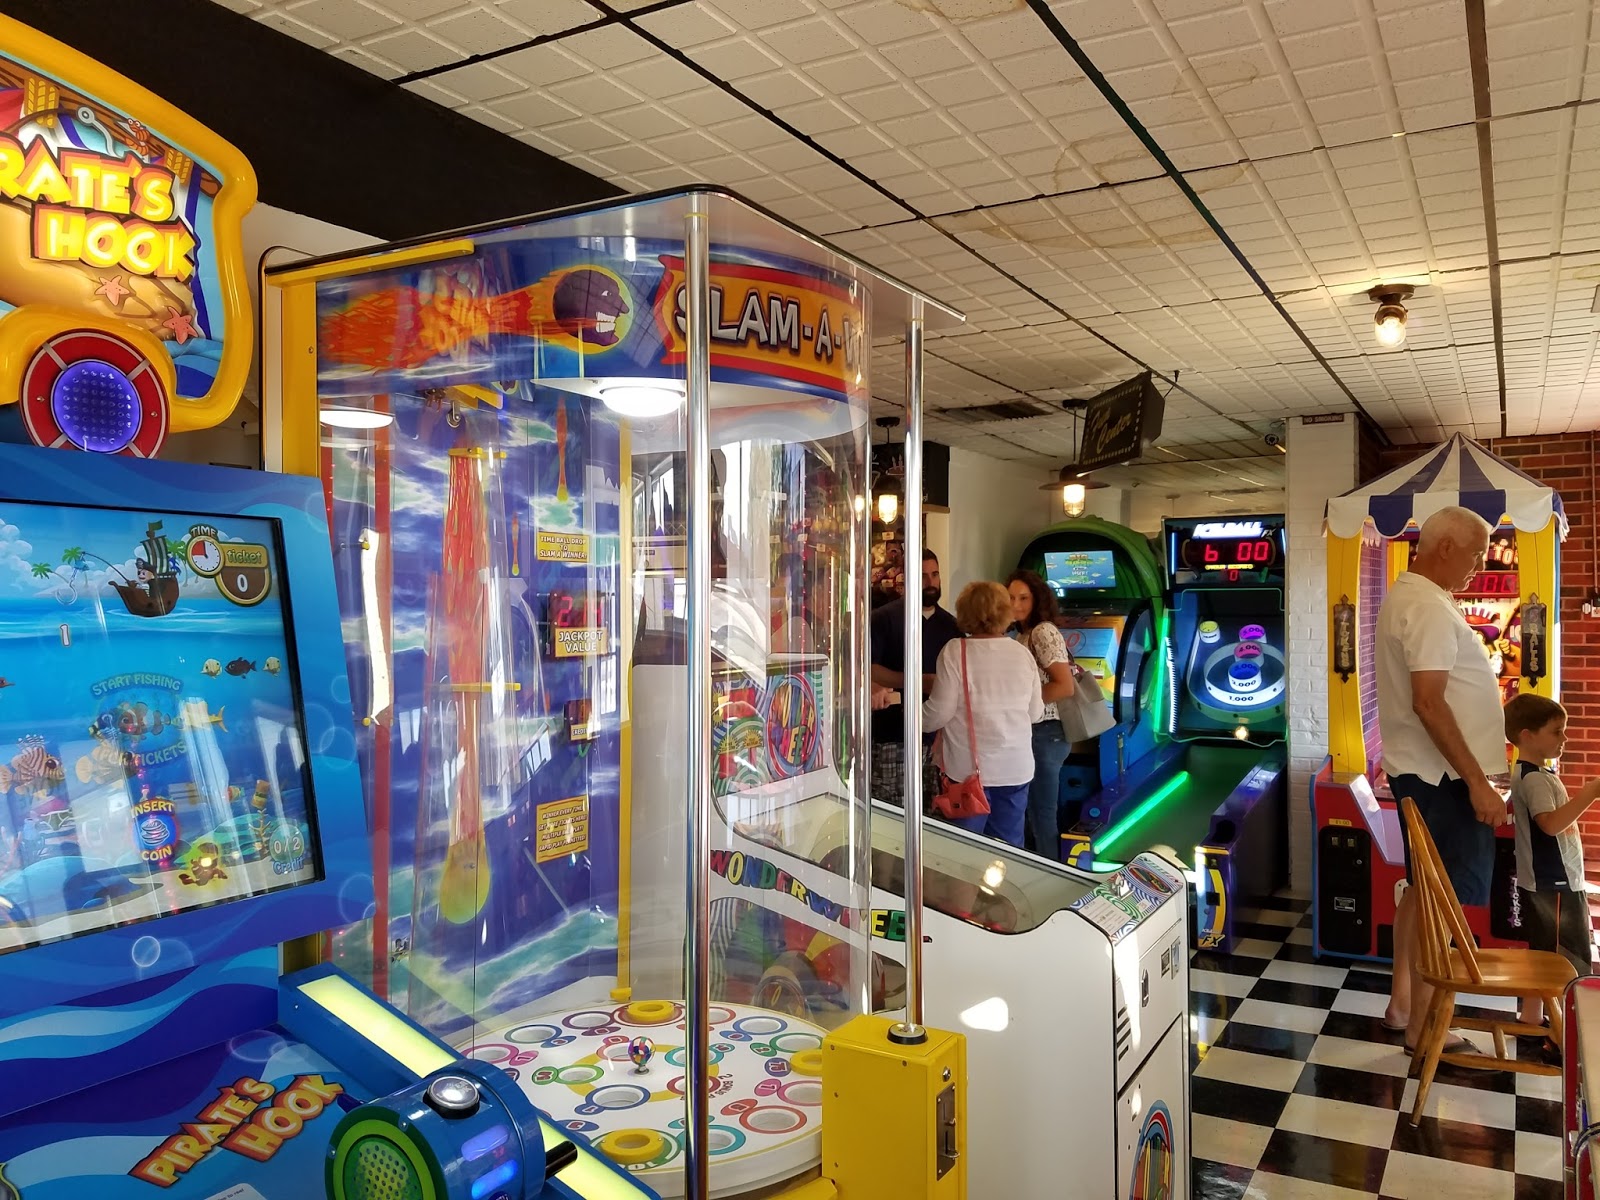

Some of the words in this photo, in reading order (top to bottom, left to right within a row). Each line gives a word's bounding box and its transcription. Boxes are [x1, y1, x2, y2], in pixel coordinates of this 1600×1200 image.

[39, 208, 195, 282] HOOK
[190, 525, 217, 537] TIME
[556, 537, 570, 545] BALL
[226, 549, 262, 564] ticket
[540, 549, 556, 557] SLAM
[1237, 541, 1269, 561] 00
[236, 573, 248, 592] 0
[558, 630, 604, 643] JACKPOT
[565, 642, 598, 653] VALUE
[1529, 623, 1540, 673] BALLS
[92, 674, 131, 696] START
[134, 673, 181, 691] FISHING
[133, 741, 187, 767] TICKETS
[131, 801, 175, 818] INSERT
[141, 846, 172, 861] COIN
[273, 858, 305, 875] Credit
[710, 849, 808, 905] WONDER
[1511, 877, 1522, 927] TICKETS
[222, 1074, 343, 1161] HOOK
[132, 1076, 276, 1187] PIRATE'S
